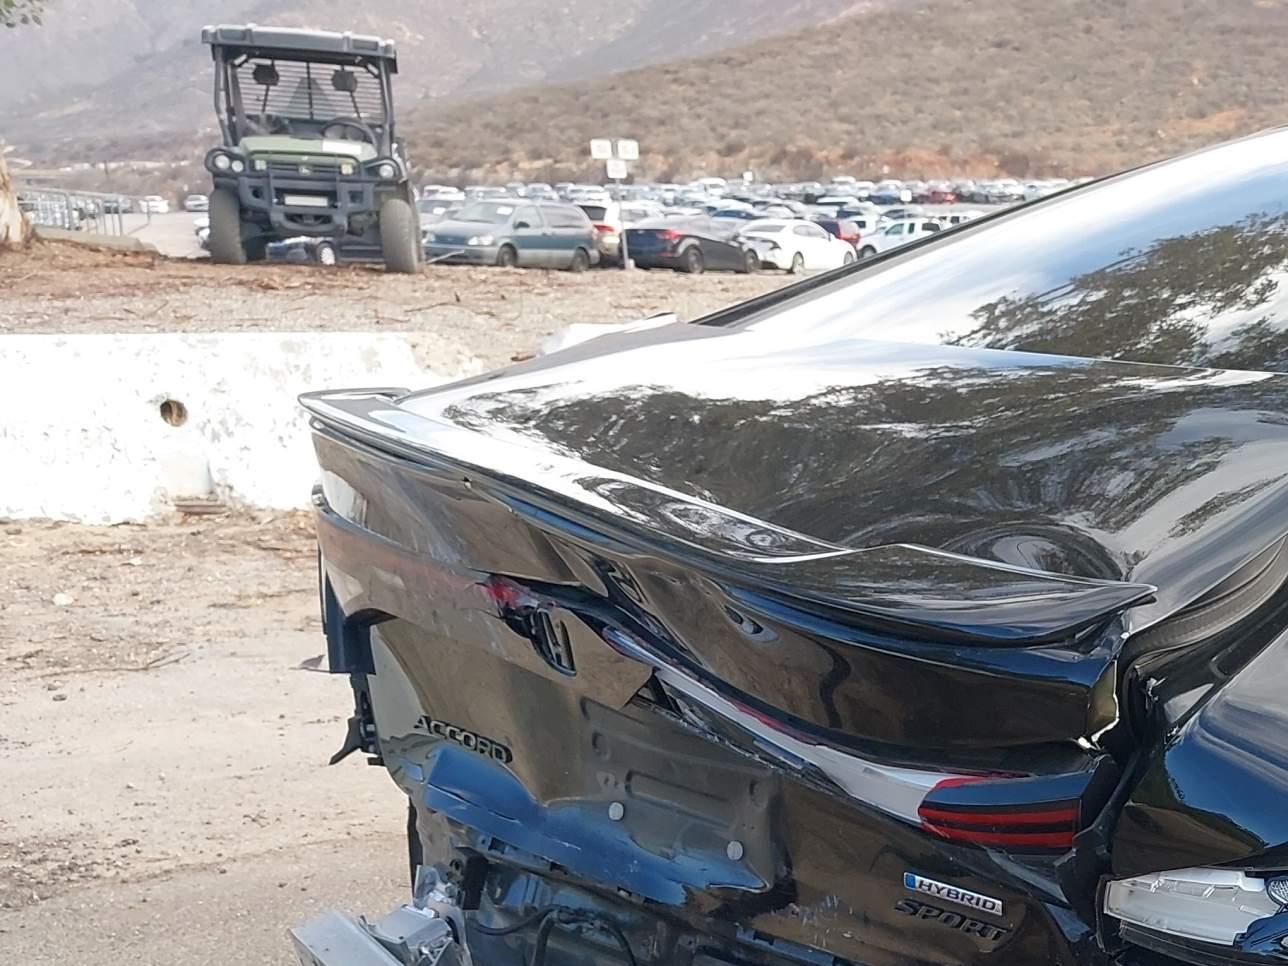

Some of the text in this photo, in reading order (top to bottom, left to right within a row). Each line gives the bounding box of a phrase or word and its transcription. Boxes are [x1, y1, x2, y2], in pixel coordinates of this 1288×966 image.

[413, 715, 514, 764] ACCORD
[918, 879, 997, 911] HYBRID
[895, 897, 1013, 941] SPORT
